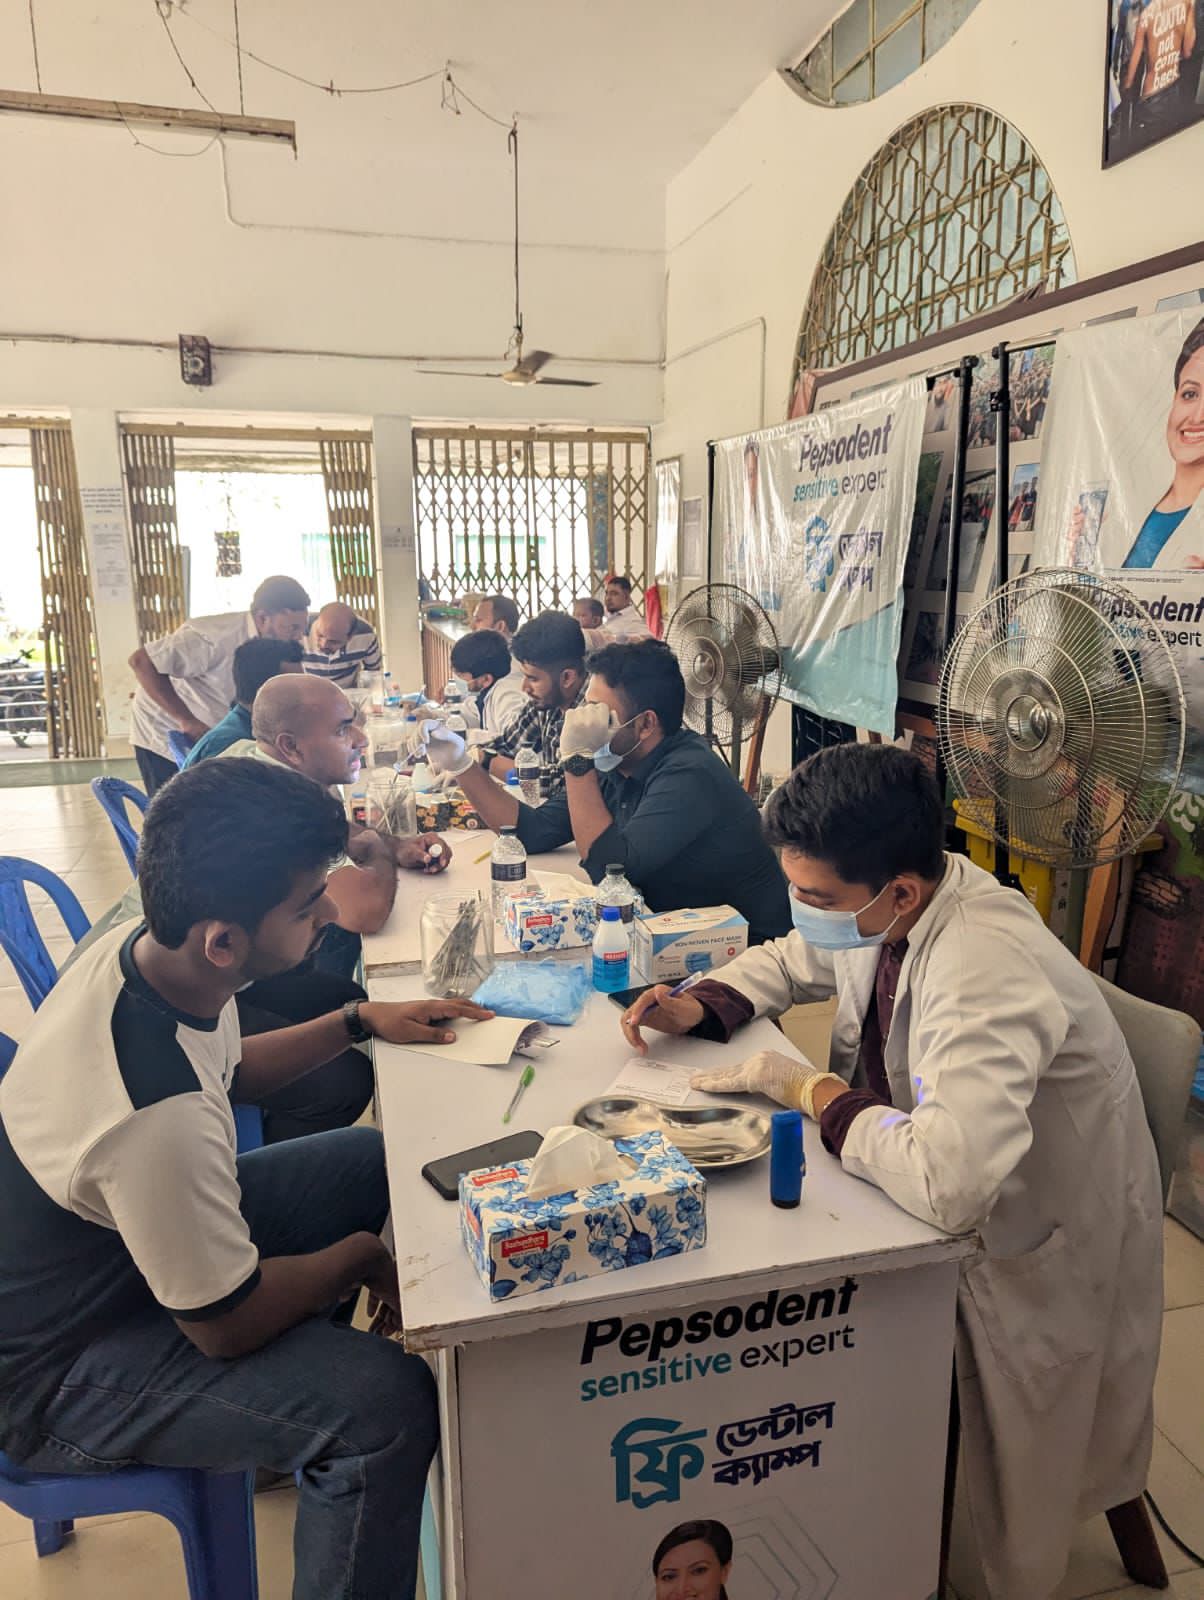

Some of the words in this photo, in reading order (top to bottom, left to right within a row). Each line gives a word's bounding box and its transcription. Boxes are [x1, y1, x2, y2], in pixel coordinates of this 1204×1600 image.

[798, 413, 893, 478] Pepsodent
[793, 475, 839, 502] sensitive
[580, 1277, 858, 1365] Pepsodent
[580, 1352, 732, 1402] sensitive
[740, 1324, 855, 1368] expert
[716, 1401, 836, 1456] ডেন্টাল
[610, 1417, 708, 1510] ফ্রি
[711, 1440, 822, 1486] ক্যাম্প
